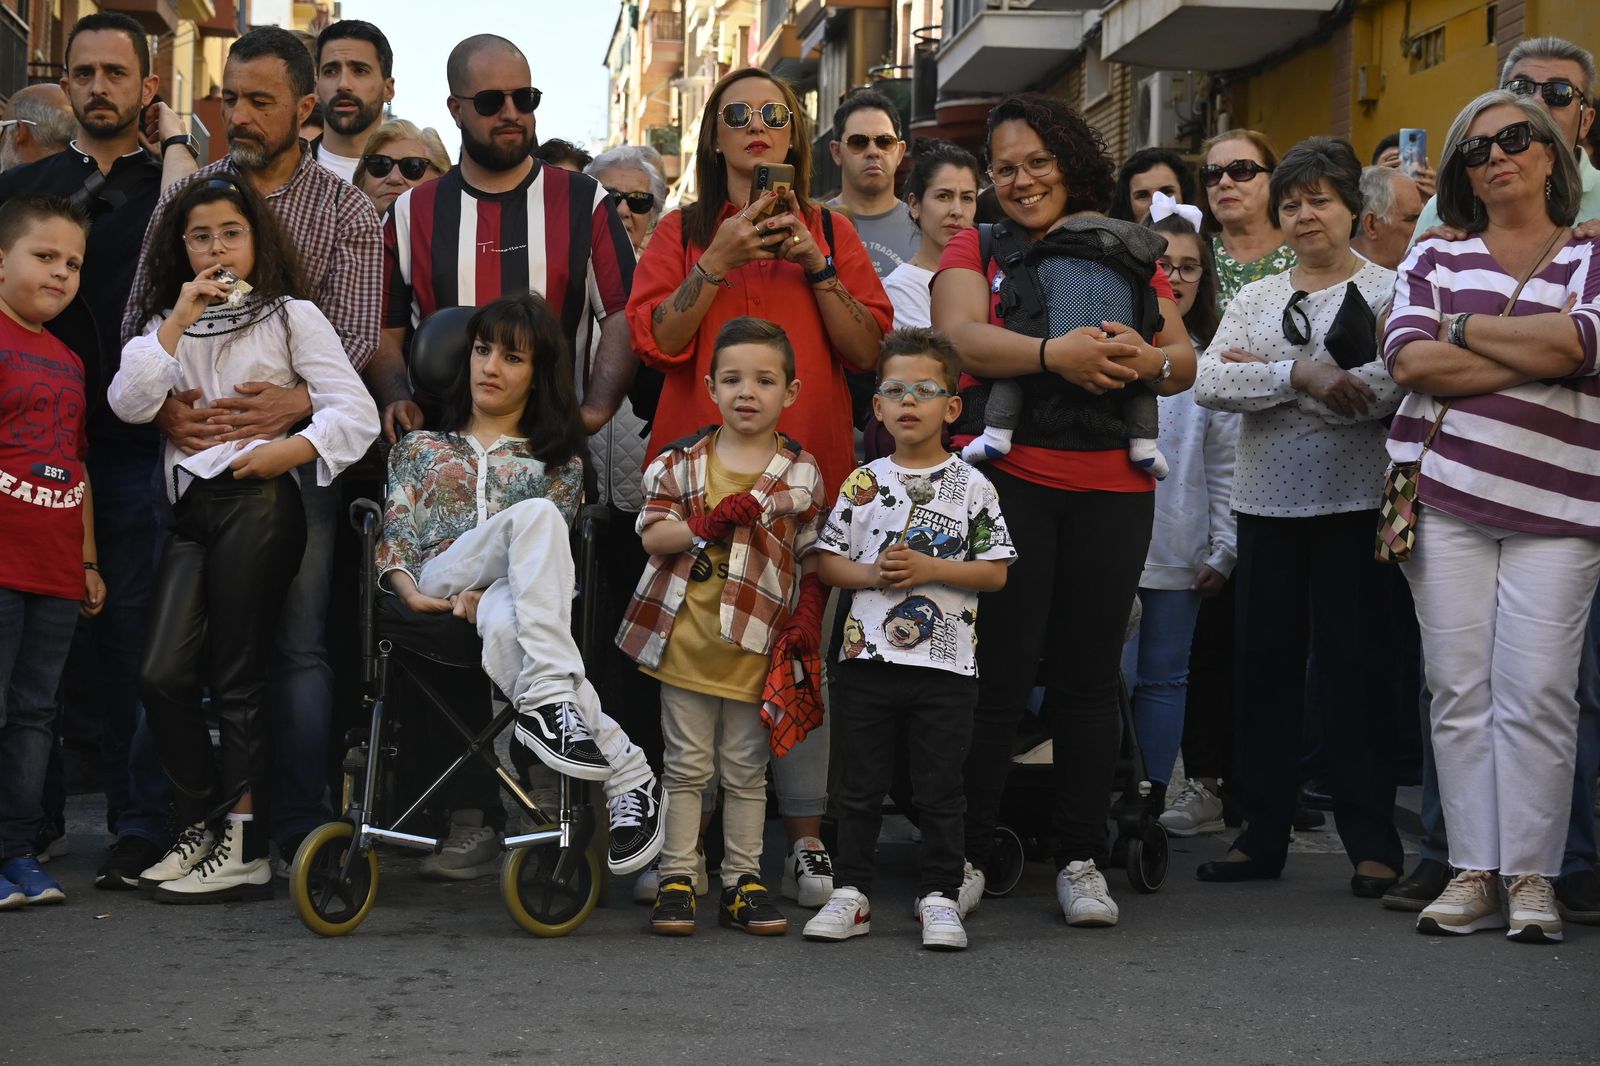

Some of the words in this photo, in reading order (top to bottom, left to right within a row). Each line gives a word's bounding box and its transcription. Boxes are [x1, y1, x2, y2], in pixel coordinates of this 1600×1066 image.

[0, 469, 86, 509] EARLESS
[44, 465, 66, 481] EST.
[929, 616, 946, 663] AMERICA
[944, 617, 957, 666] CAPTAIN
